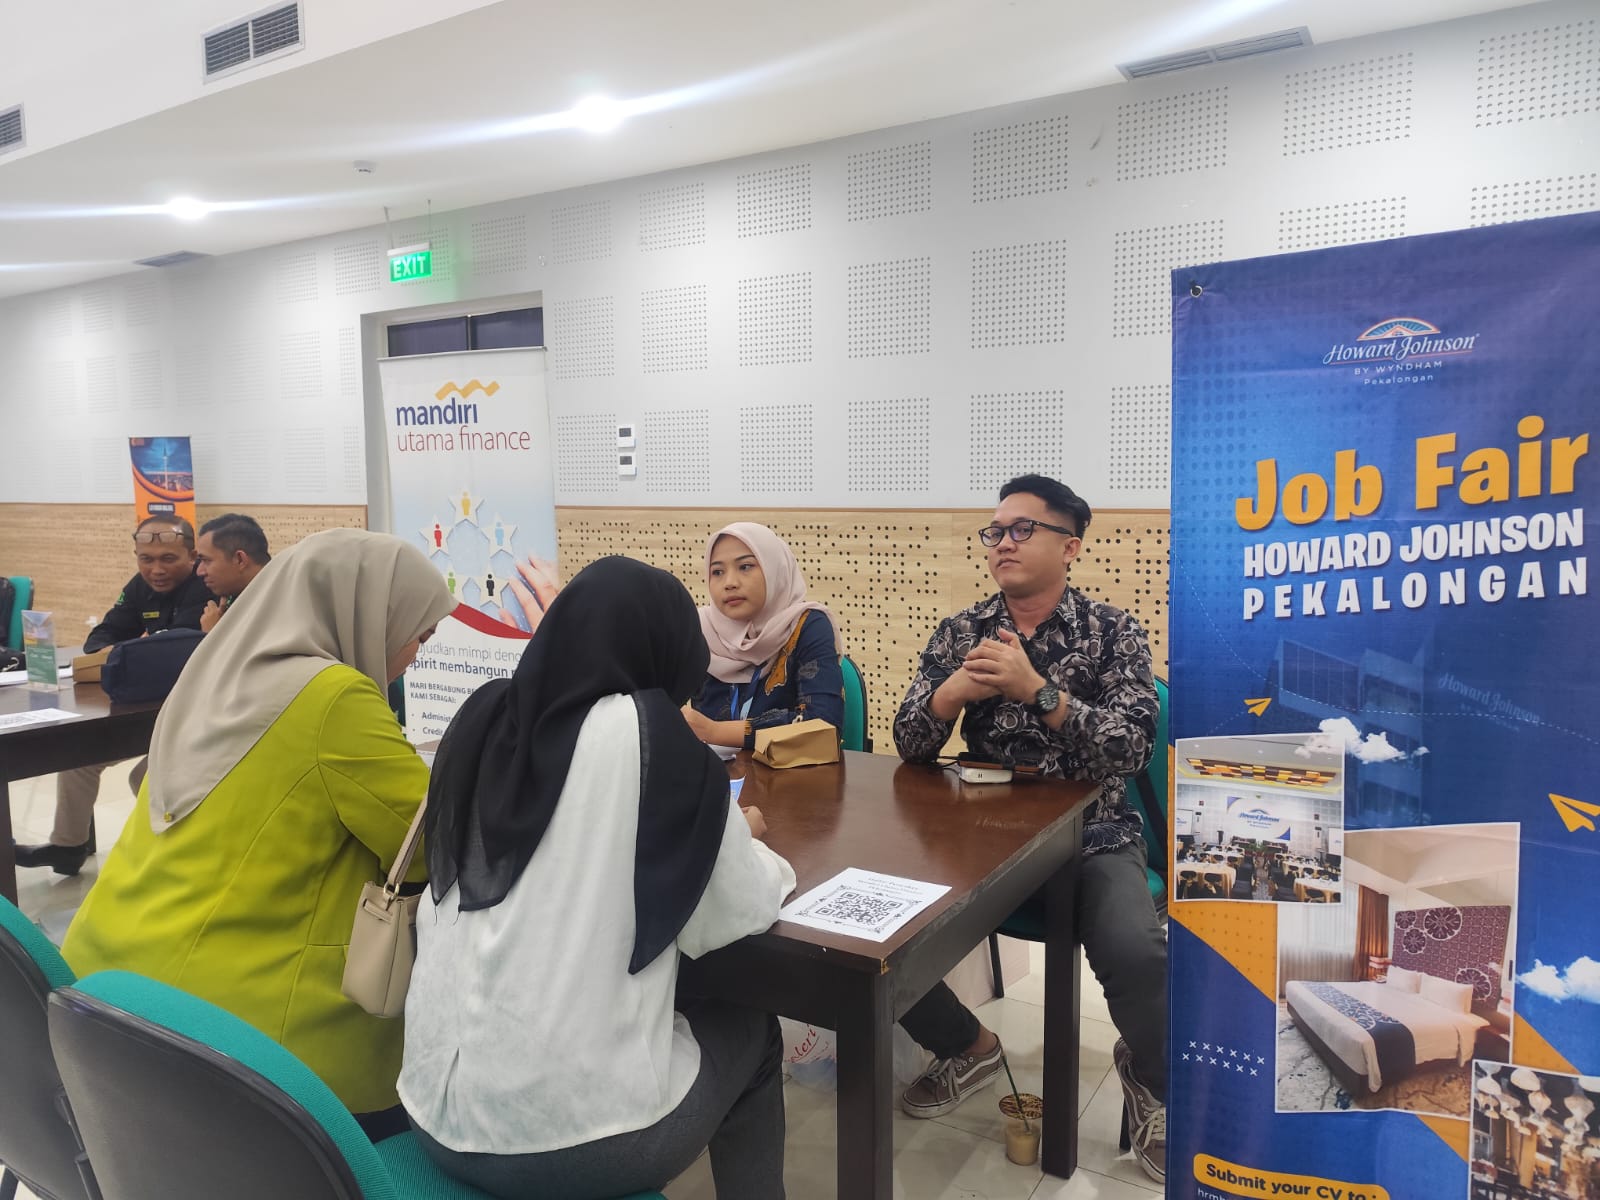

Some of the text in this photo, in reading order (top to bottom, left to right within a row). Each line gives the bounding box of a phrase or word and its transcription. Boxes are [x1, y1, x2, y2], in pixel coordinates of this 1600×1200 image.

[393, 255, 426, 278] EXIT
[1322, 334, 1475, 365] Howard Johnson
[1354, 361, 1443, 376] BY WYNDHAM
[1364, 374, 1434, 386] Pekalongan
[396, 398, 478, 426] mandiri
[397, 425, 532, 452] utama finance
[1235, 415, 1590, 531] Job Fair
[1243, 508, 1584, 578] HOWARD JOHNSON
[1243, 557, 1588, 620] PEKALONGAN
[458, 645, 492, 662] mimpi
[439, 661, 509, 679] membangun
[410, 682, 427, 690] MARI
[428, 683, 466, 695] BERGABUNG
[410, 692, 428, 701] KAMI
[1438, 672, 1490, 706] Howard
[1206, 1163, 1267, 1191] Submit
[1271, 1181, 1312, 1195] your
[1316, 1185, 1343, 1200] CV
